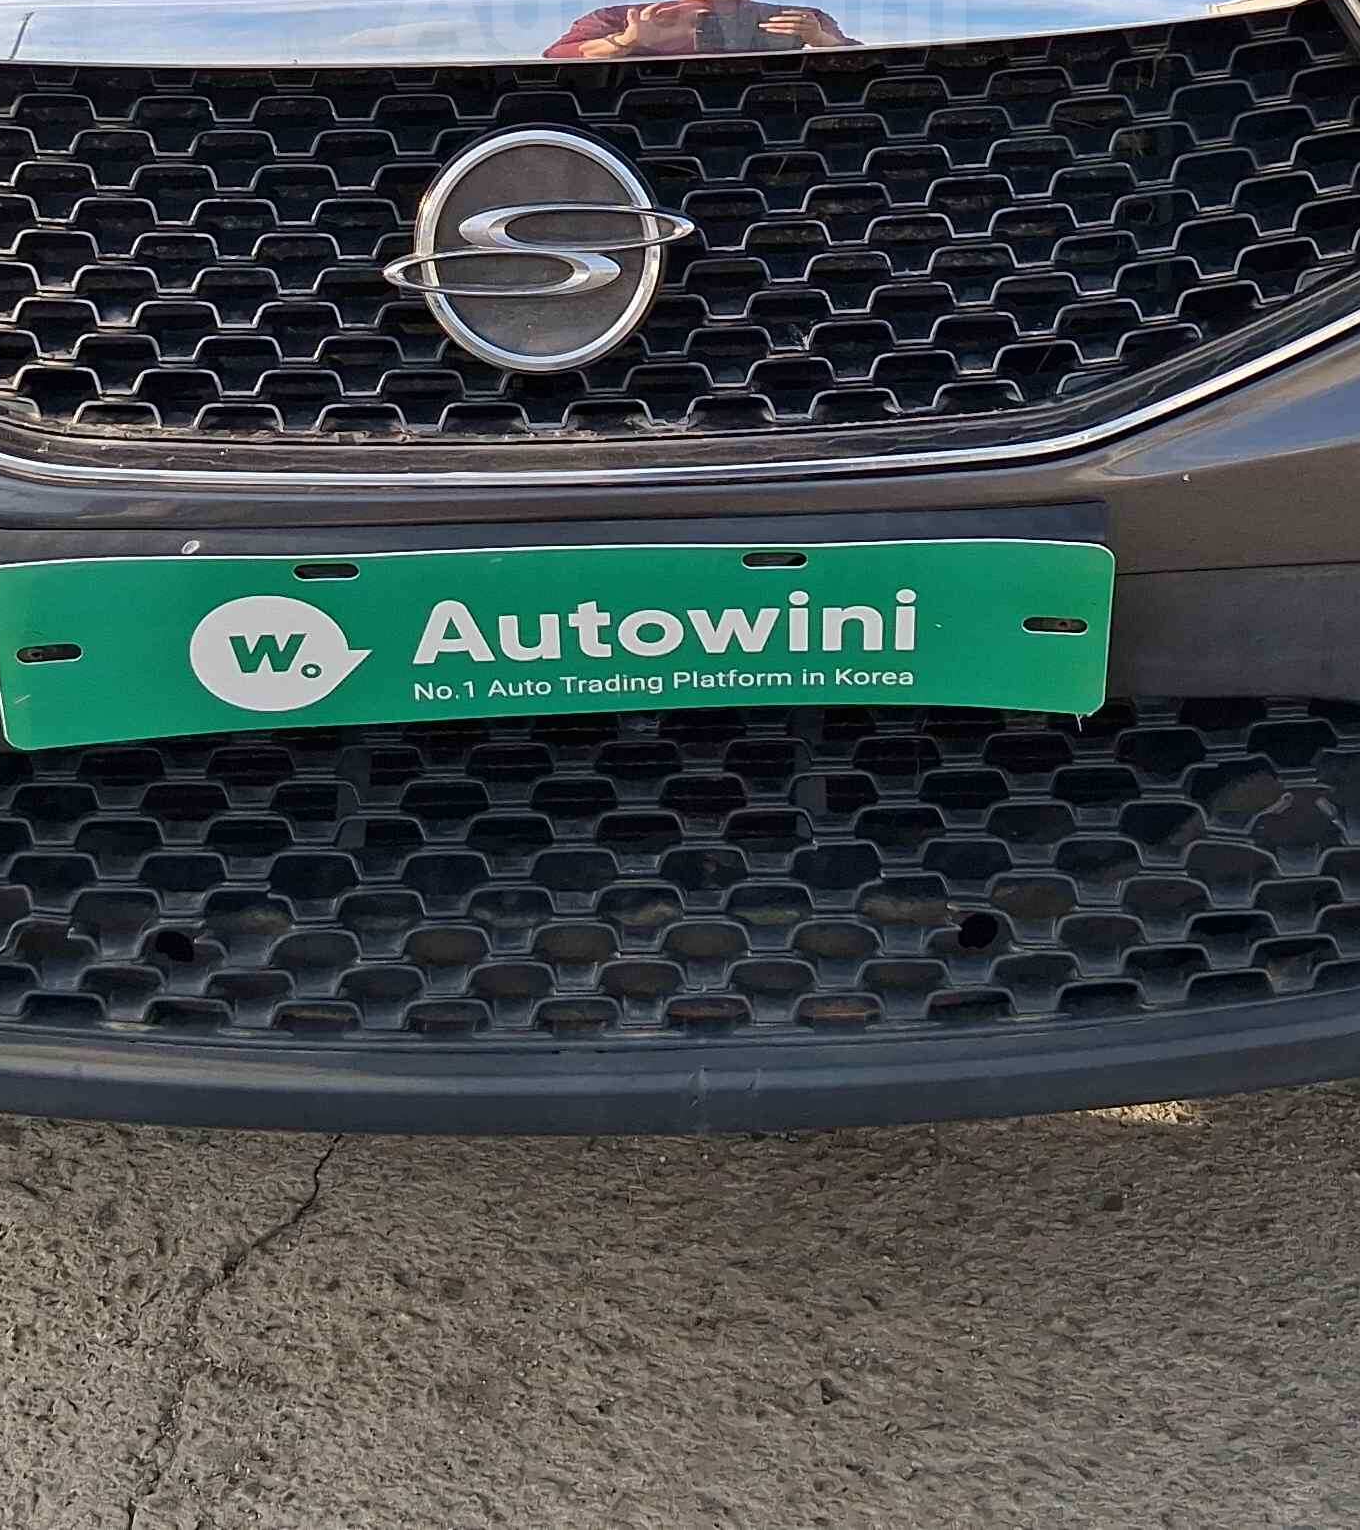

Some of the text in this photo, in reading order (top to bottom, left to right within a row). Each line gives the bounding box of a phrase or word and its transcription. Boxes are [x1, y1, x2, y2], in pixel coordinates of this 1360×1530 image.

[412, 588, 917, 664] Autowini
[413, 668, 915, 701] No.1 Auto Trading Platform in Korea
